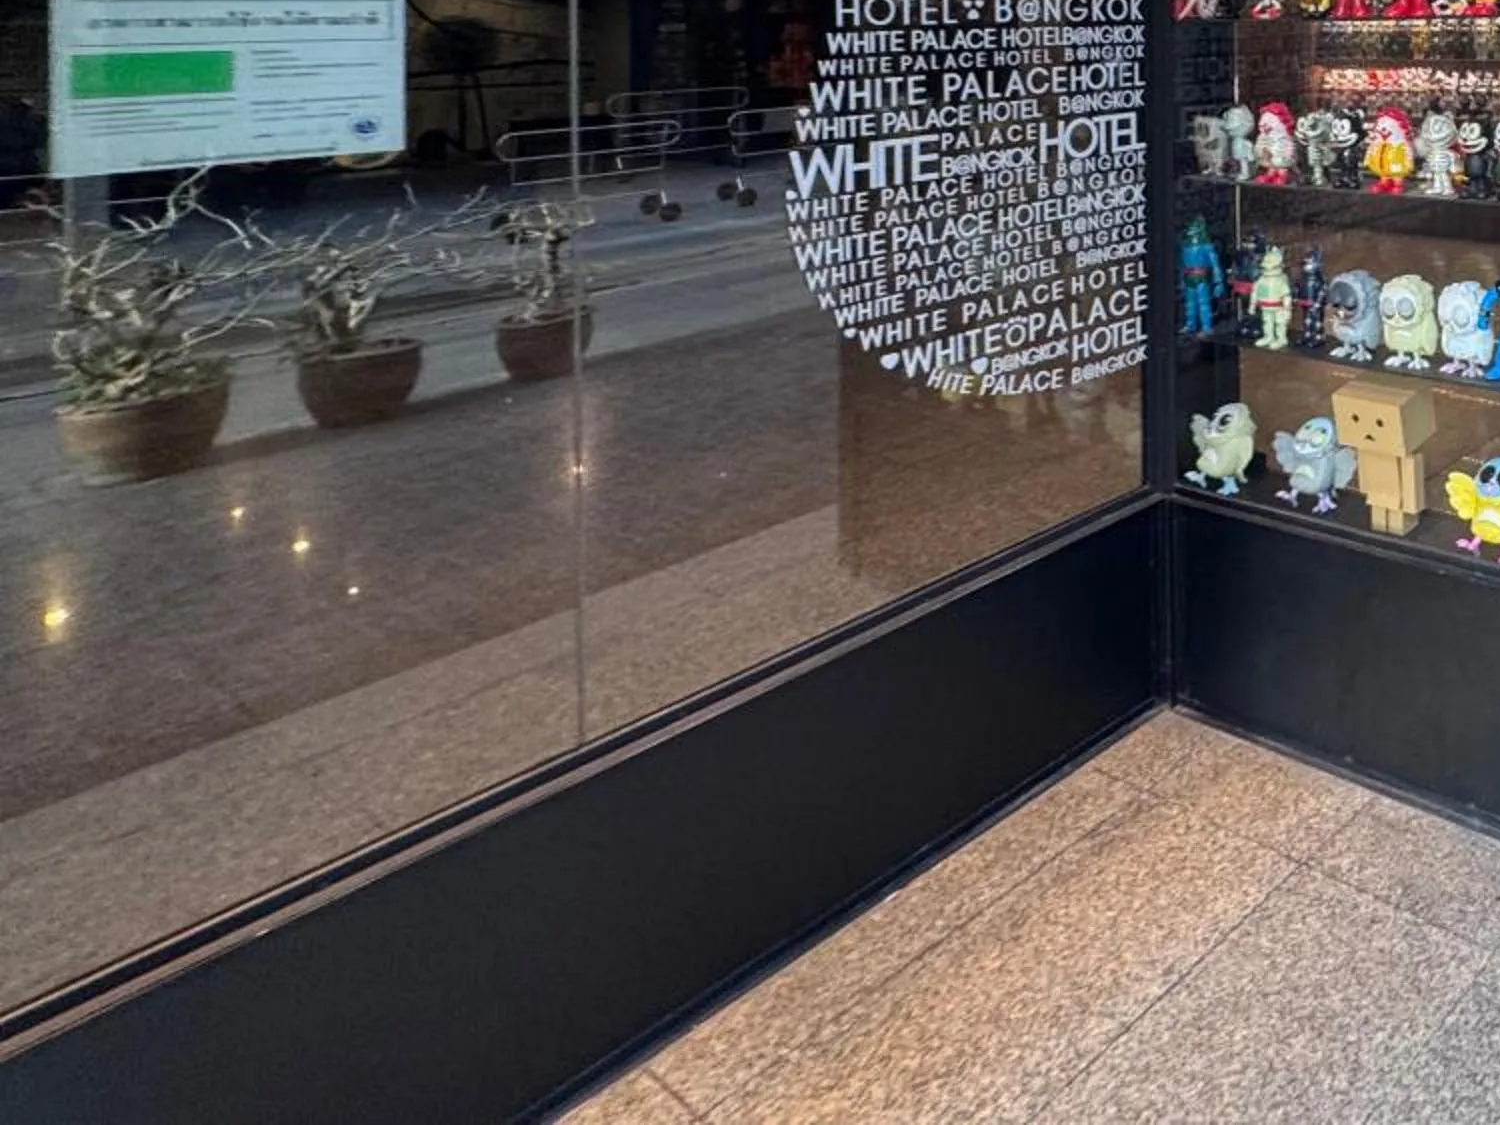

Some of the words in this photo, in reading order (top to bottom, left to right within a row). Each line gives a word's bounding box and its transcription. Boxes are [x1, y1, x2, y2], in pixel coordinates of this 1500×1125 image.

[817, 55, 893, 77] WHITE
[900, 50, 987, 72] PALACE
[993, 48, 1052, 66] HOTEL
[825, 31, 906, 56] WHITE
[910, 27, 998, 52] PALACE
[1001, 27, 1063, 49] HOTEL
[809, 75, 928, 114] WHITE
[942, 65, 1068, 103] PALACE
[1069, 62, 1147, 92] HOTEL
[794, 114, 876, 143] WHITE
[881, 105, 973, 134] PALACE
[978, 99, 1043, 124] HOTEL
[788, 133, 941, 200] WHITE
[941, 122, 1038, 151] PALACE
[1038, 111, 1147, 165] HOTEL
[785, 191, 870, 222] WHITE
[880, 177, 974, 207] PALACE
[983, 166, 1047, 190] HOTEL
[874, 197, 959, 229] PALACE
[966, 186, 1029, 212] HOTEL
[794, 230, 887, 271] WHITE
[891, 213, 993, 250] PALACE
[998, 198, 1068, 231] HOTEL
[805, 256, 887, 292] WHITE
[892, 236, 985, 272] PALACE
[991, 225, 1055, 253] HOTEL
[834, 293, 906, 328] WHITE
[914, 273, 993, 308] PALACE
[1002, 258, 1060, 286] HOTEL
[895, 260, 976, 292] PALACE
[983, 244, 1043, 271] HOTEL
[858, 308, 949, 351] WHITE
[961, 279, 1065, 324] PALACE
[1070, 261, 1149, 296] HOTEL
[902, 321, 1004, 379] WHITE
[1029, 285, 1149, 342] PALACE
[1071, 315, 1149, 362] HOTEL
[978, 366, 1066, 397] PALACE
